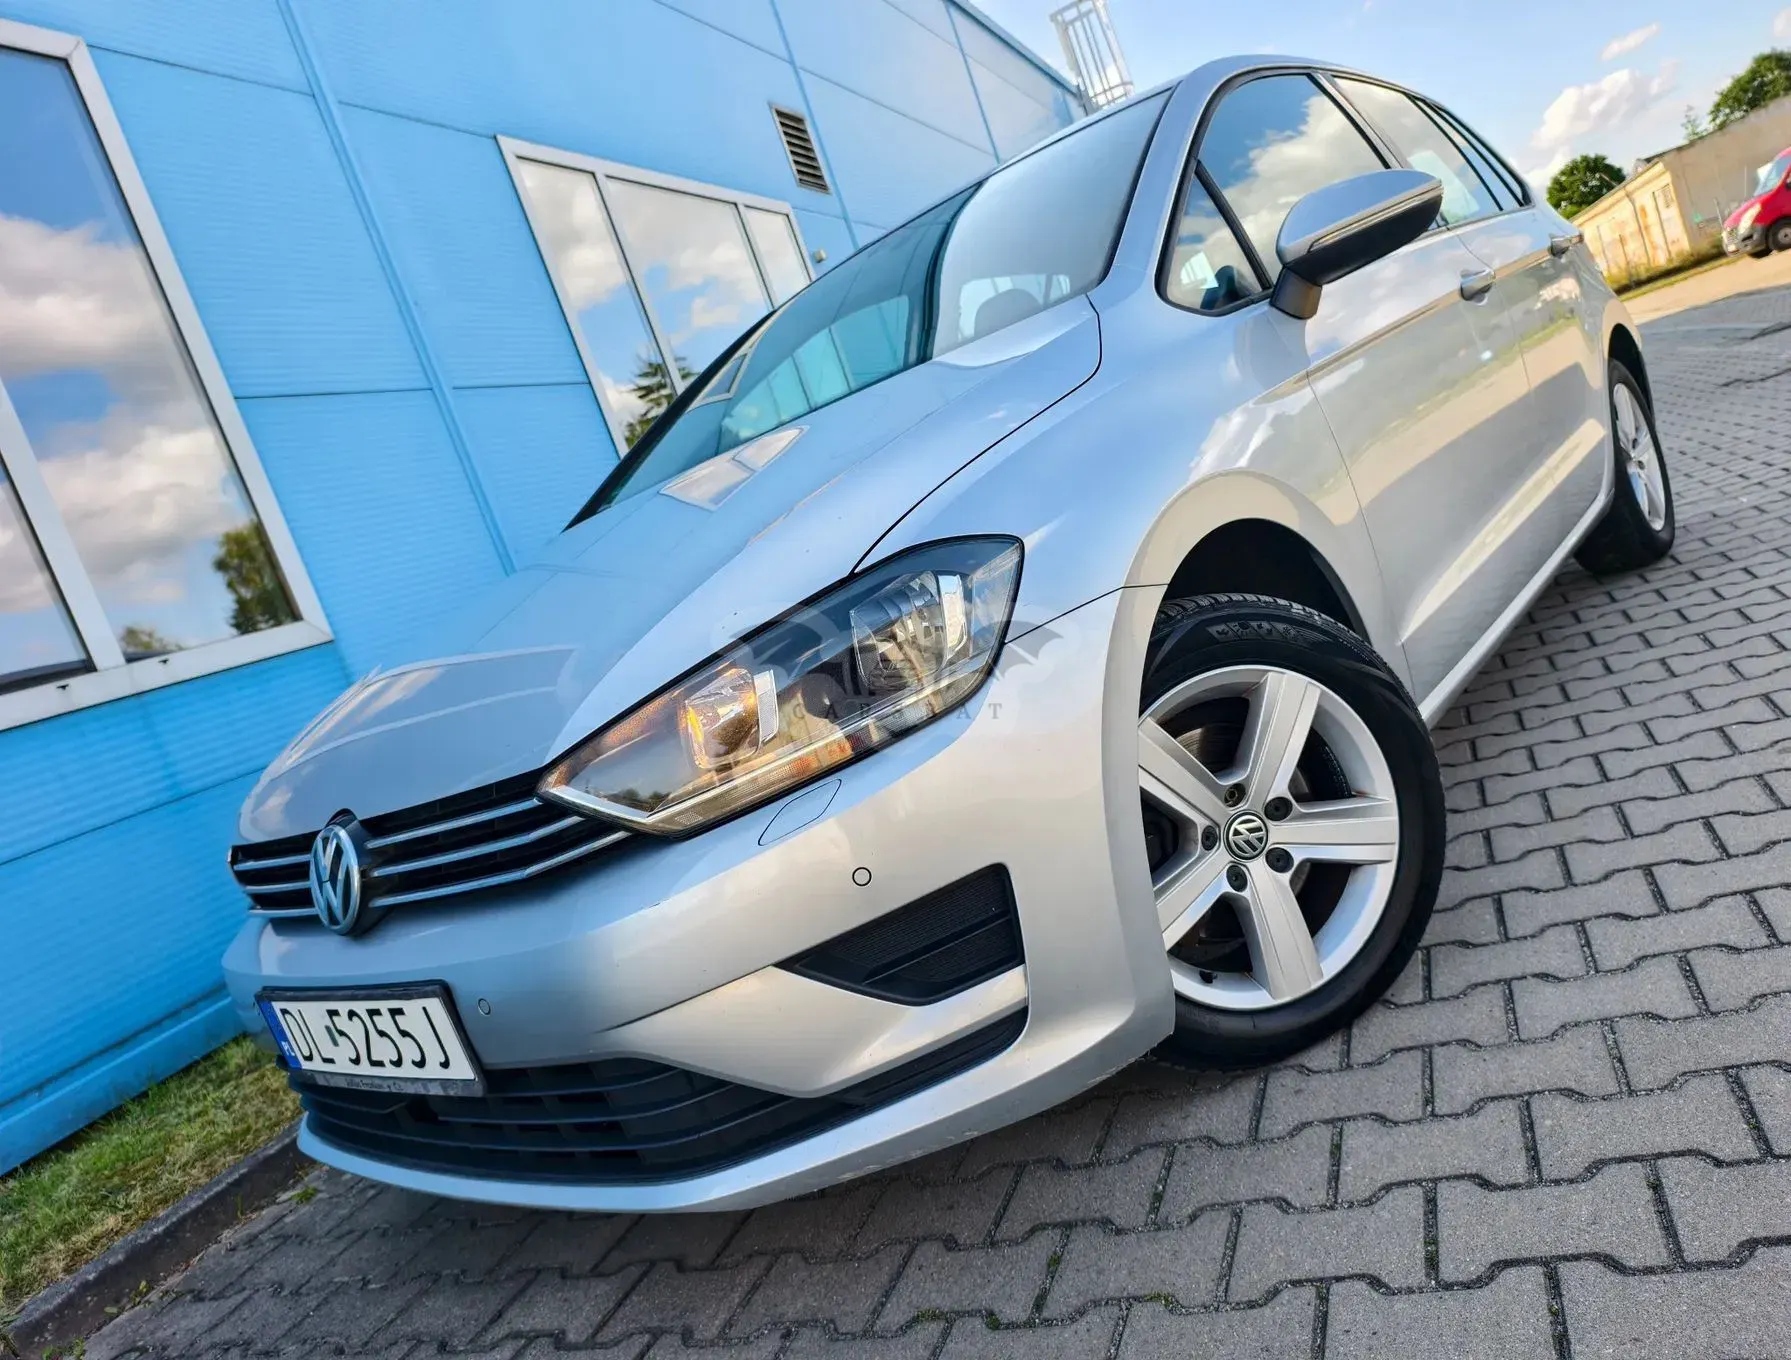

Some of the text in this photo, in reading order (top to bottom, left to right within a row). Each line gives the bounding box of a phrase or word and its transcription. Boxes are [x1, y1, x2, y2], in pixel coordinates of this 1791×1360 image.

[1228, 814, 1266, 858] VW
[310, 825, 360, 931] VW
[279, 1006, 450, 1069] DL 5255J
[280, 1040, 296, 1057] PL
